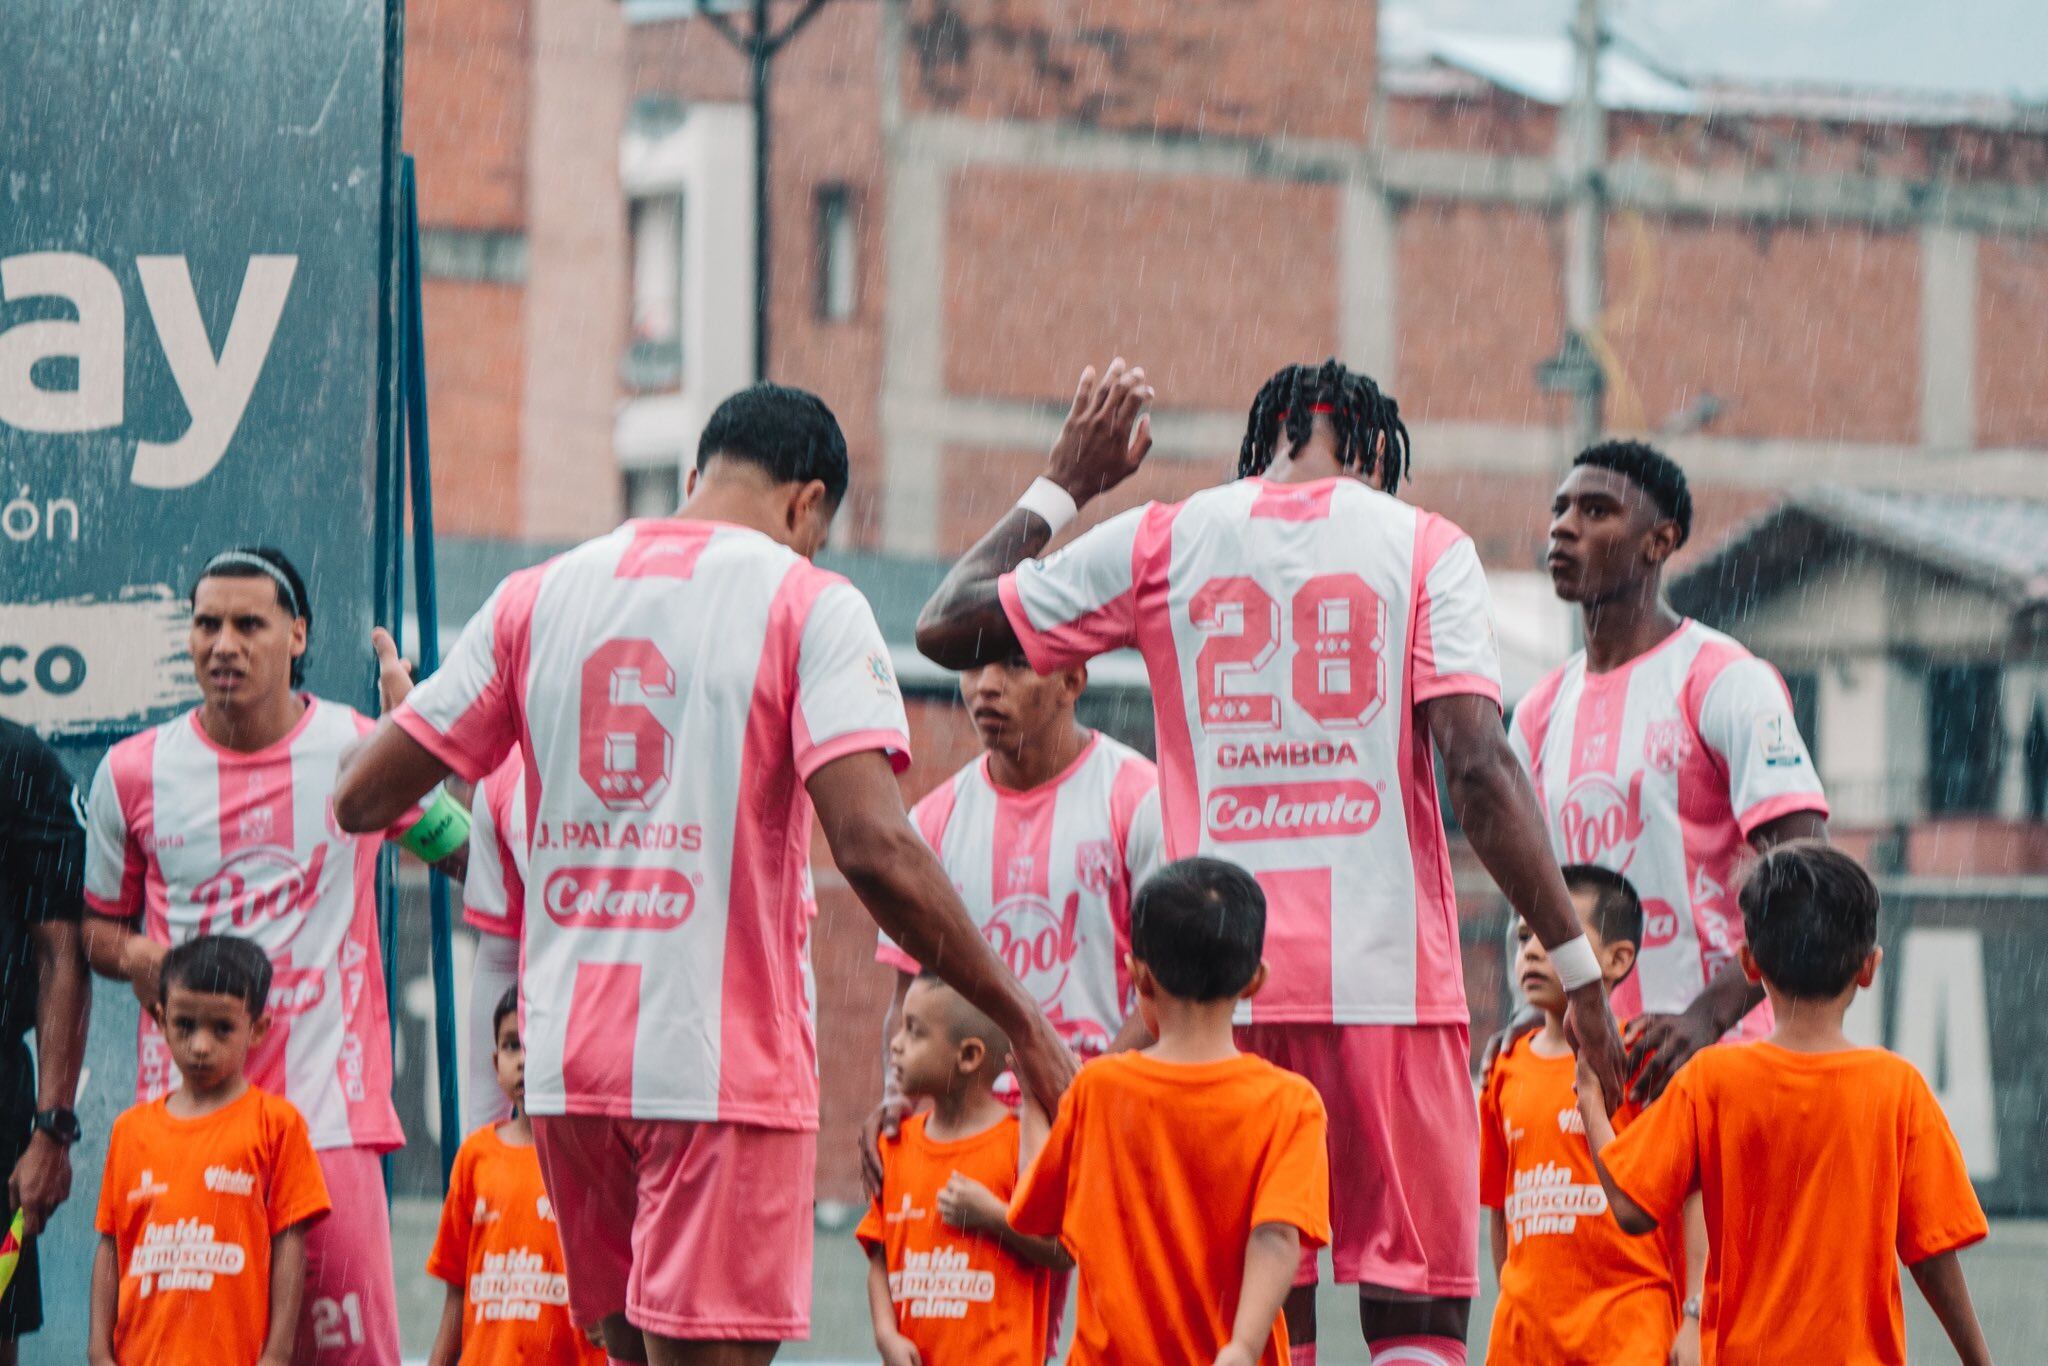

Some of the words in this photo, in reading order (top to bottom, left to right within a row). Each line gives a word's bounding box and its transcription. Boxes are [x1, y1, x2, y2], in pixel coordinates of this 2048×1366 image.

[0, 251, 299, 489] ay
[2, 484, 79, 542] ón
[0, 644, 87, 696] co
[1189, 573, 1387, 734] 28
[579, 637, 675, 811] 6
[1217, 742, 1358, 769] GAMBOA
[1208, 793, 1375, 831] Colanta
[548, 875, 689, 918] Colanta
[311, 1291, 366, 1349] 21
